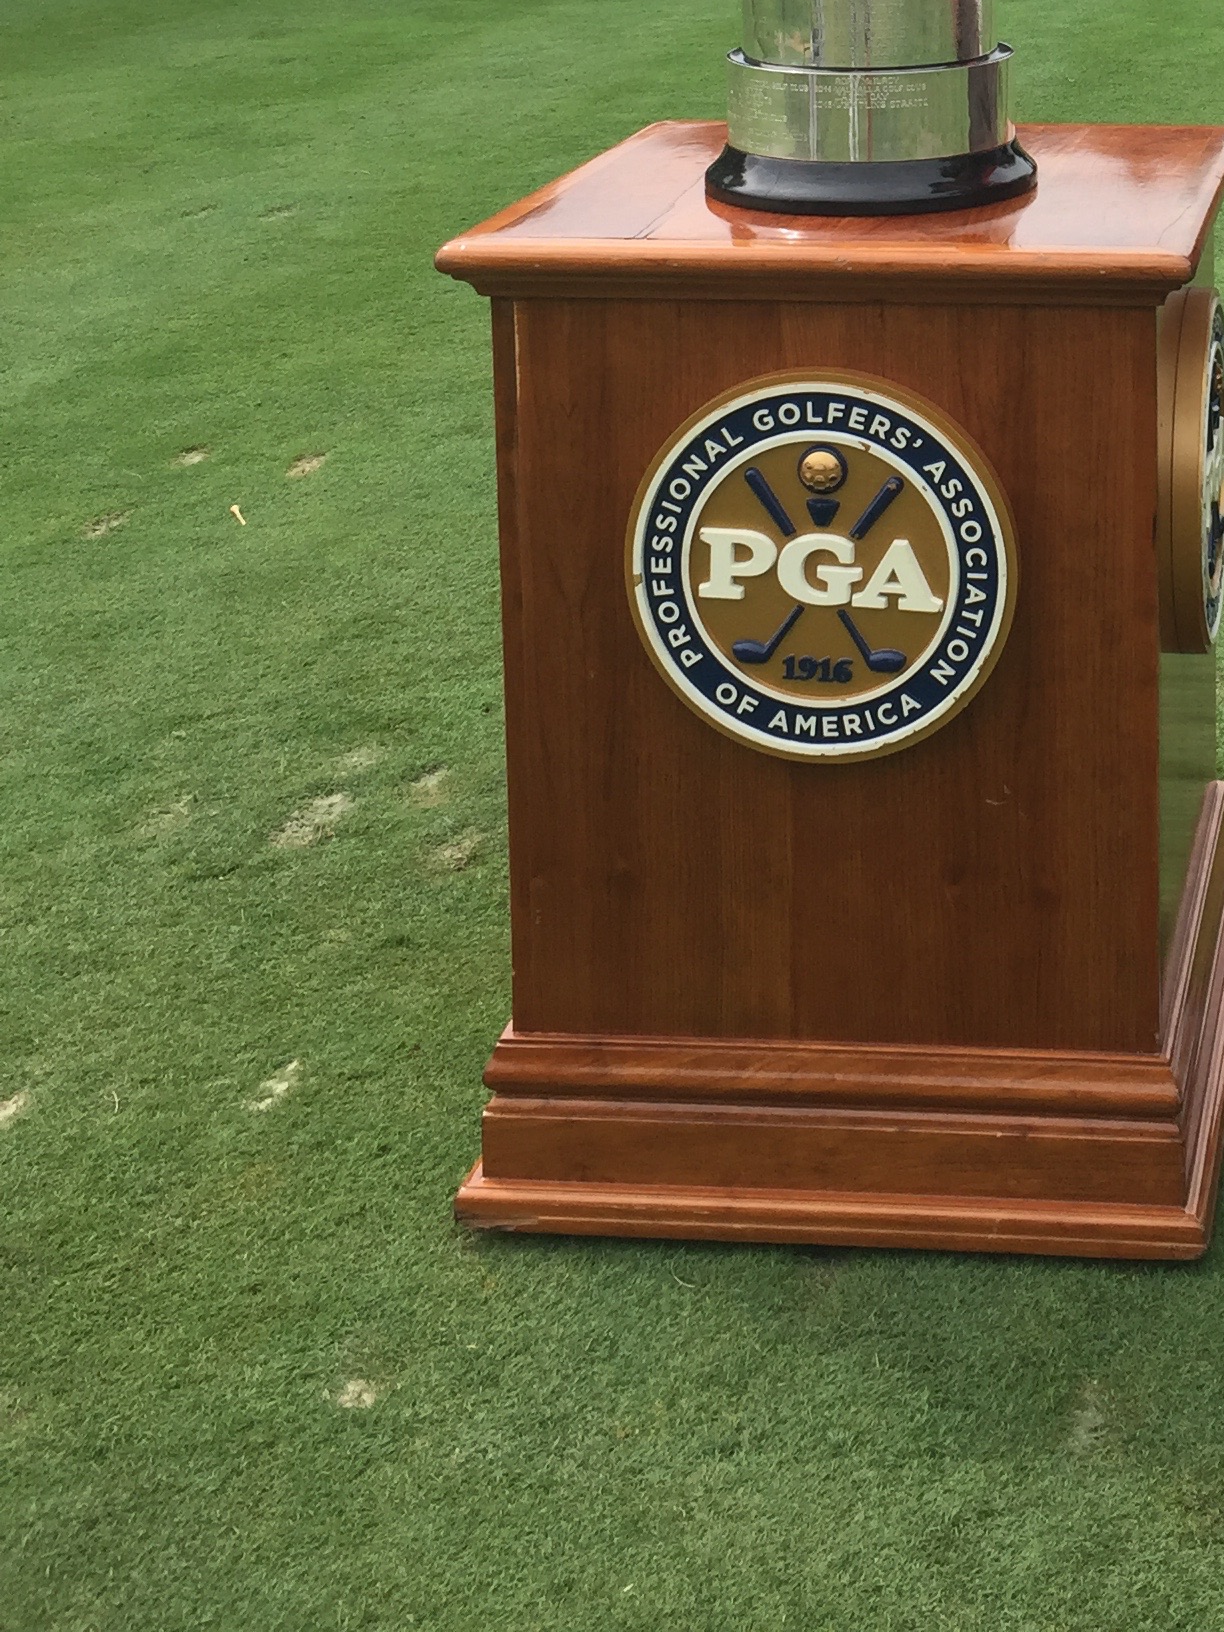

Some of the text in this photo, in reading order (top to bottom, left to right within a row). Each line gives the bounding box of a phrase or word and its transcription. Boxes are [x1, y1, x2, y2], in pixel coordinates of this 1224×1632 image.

[650, 427, 744, 669] PROFESSIONAL
[922, 460, 989, 687] ASSOCIATION
[698, 527, 944, 613] PGA
[781, 654, 854, 683] 1916
[715, 682, 922, 738] OF AMERICA
